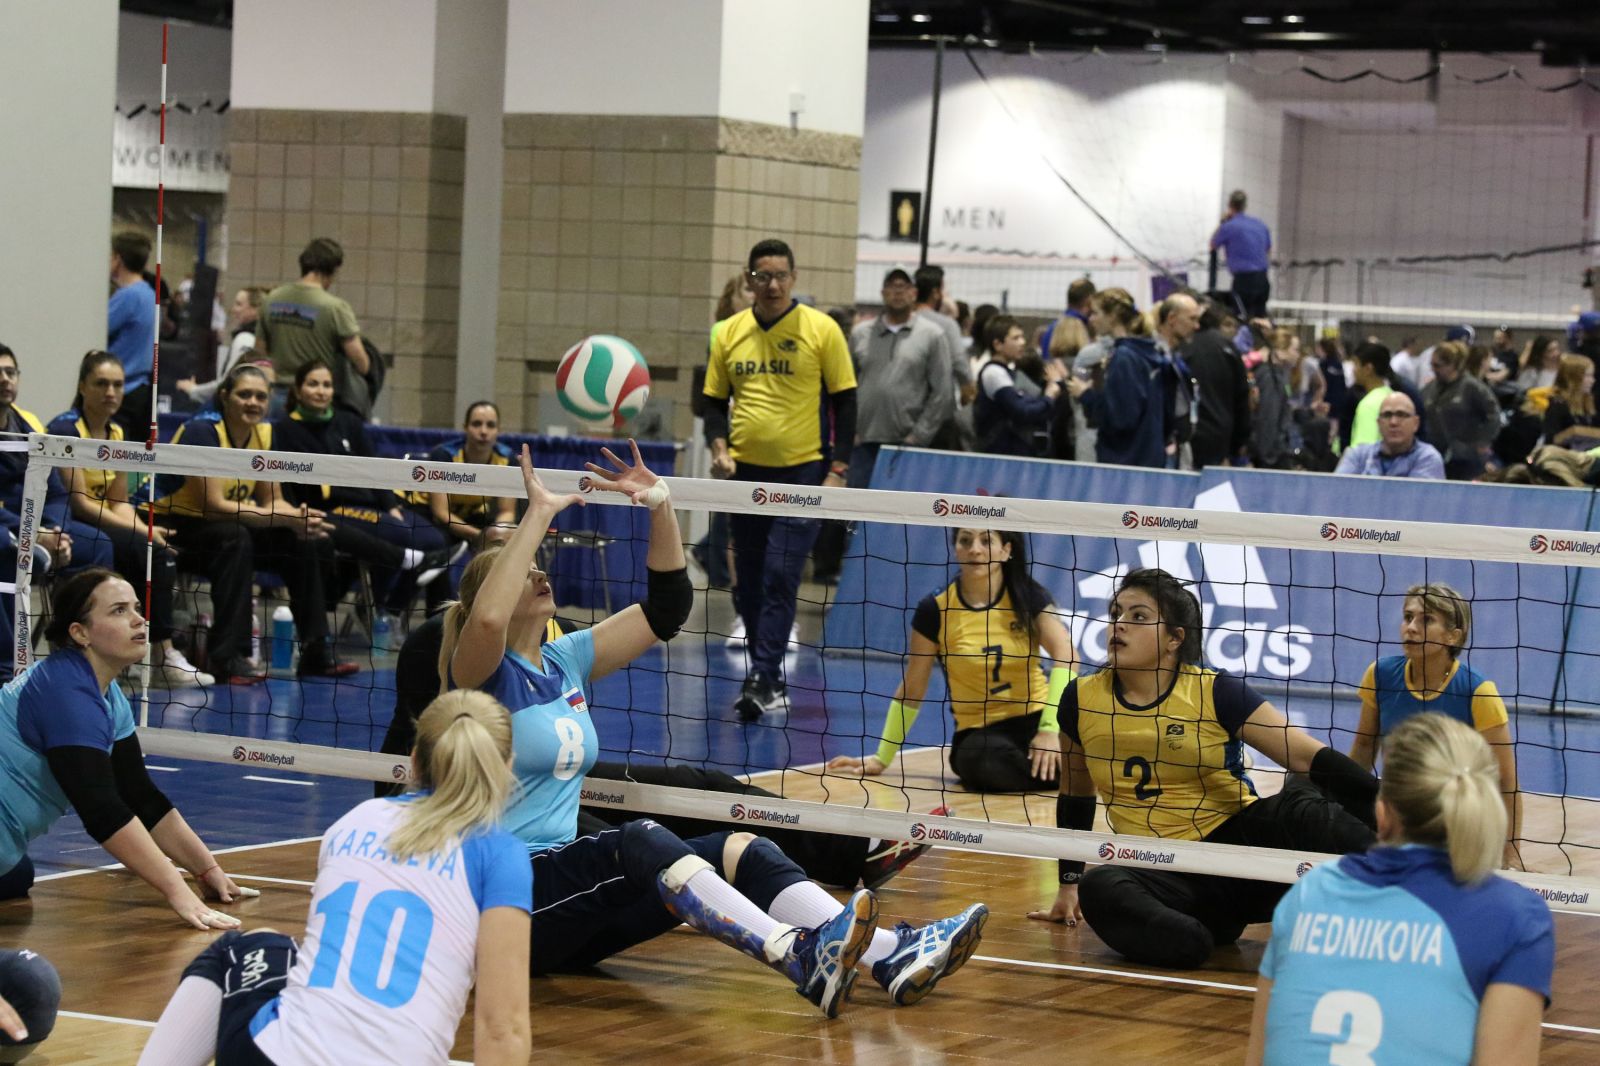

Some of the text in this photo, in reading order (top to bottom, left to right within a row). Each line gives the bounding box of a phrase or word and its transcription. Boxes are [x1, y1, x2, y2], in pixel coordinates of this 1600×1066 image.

[117, 148, 230, 172] WOMEN
[943, 208, 1005, 229] MEN
[735, 360, 794, 376] BRASIL
[1141, 516, 1199, 531] USAVolleyball
[1340, 527, 1401, 543] USAVolleyball
[982, 645, 1003, 683] 7
[553, 717, 585, 781] 8
[1123, 756, 1163, 800] 2
[580, 790, 625, 804] SAVolleyball
[327, 829, 458, 880] KARAVA
[1118, 848, 1175, 865] USAVolleyball
[1528, 887, 1589, 904] AVolleyball
[307, 881, 434, 1009] 10
[1289, 912, 1444, 967] MEDNIKOVA
[1309, 990, 1383, 1066] 3
